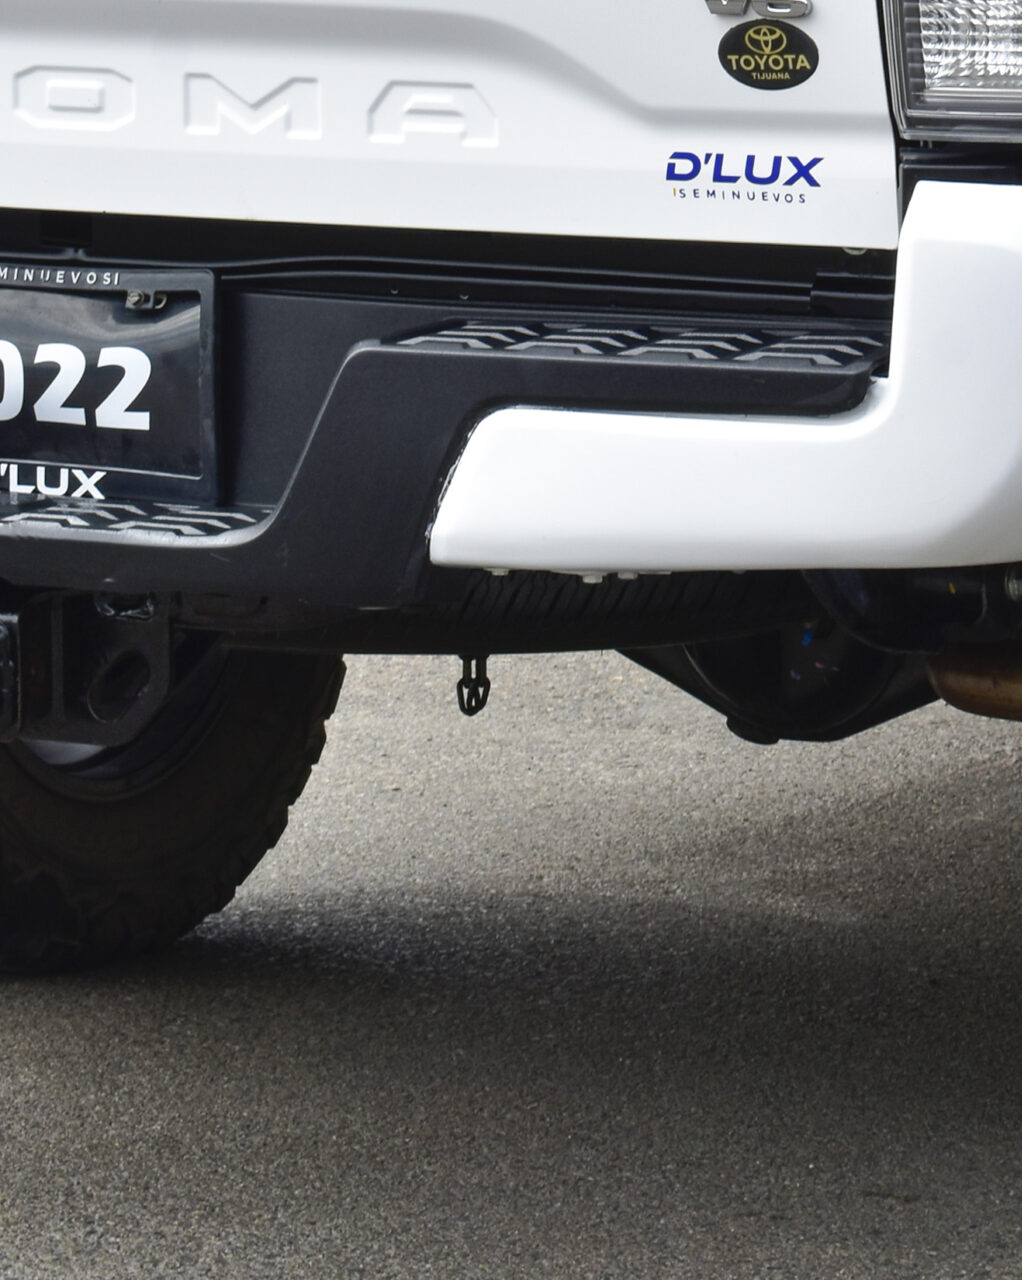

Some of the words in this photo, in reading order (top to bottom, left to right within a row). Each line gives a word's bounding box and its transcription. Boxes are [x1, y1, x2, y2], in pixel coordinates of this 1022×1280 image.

[727, 54, 811, 71] TOYOTA
[751, 71, 791, 81] TIJUANA
[665, 151, 824, 188] D'LUX
[678, 187, 806, 204] SEMINUEVOS
